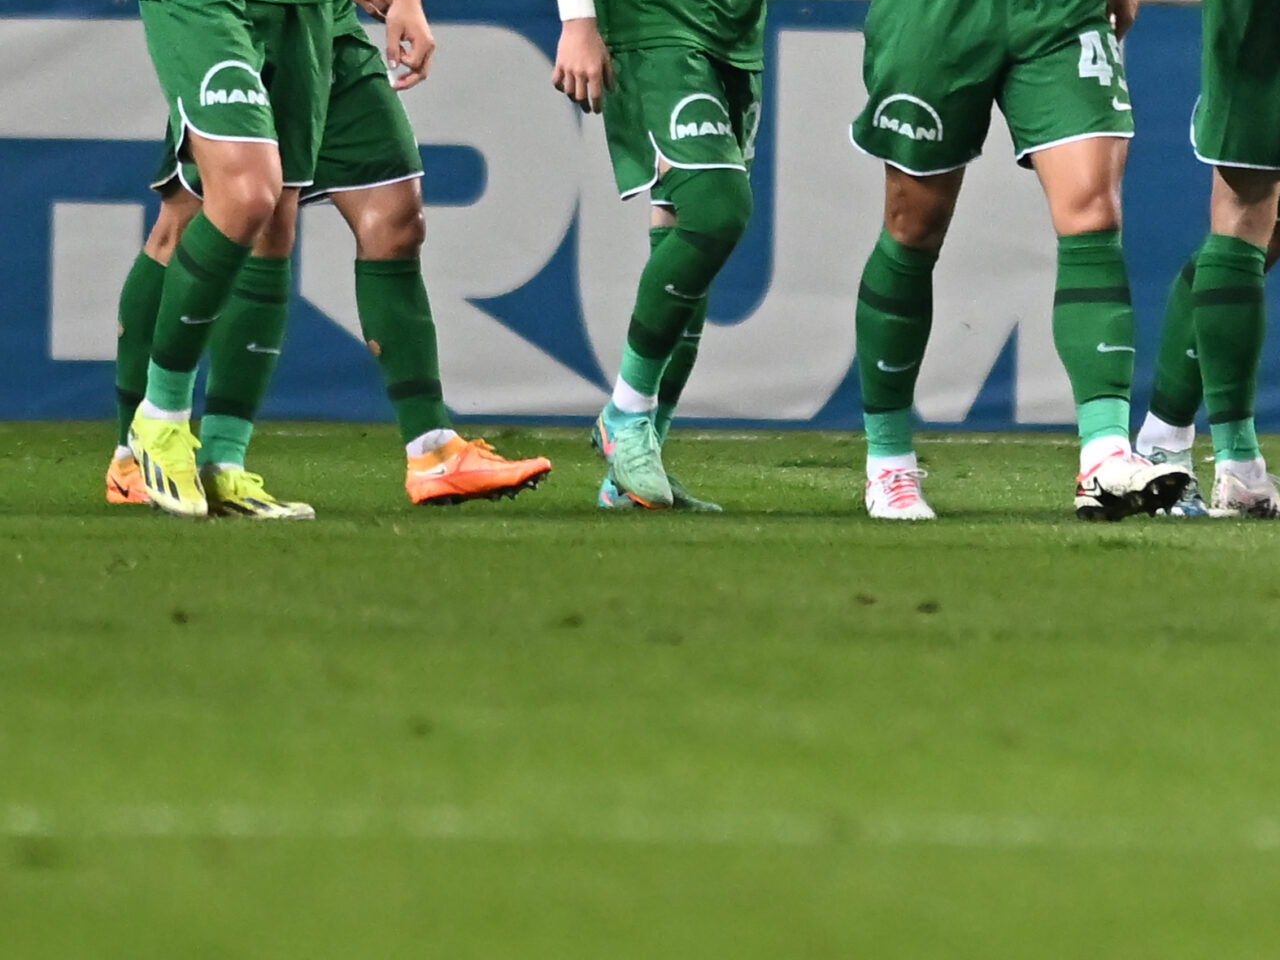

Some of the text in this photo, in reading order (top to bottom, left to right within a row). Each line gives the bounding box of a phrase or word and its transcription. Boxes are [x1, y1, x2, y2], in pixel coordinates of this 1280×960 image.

[206, 89, 268, 106] MAN
[676, 121, 734, 139] MAN
[879, 115, 937, 141] MAN
